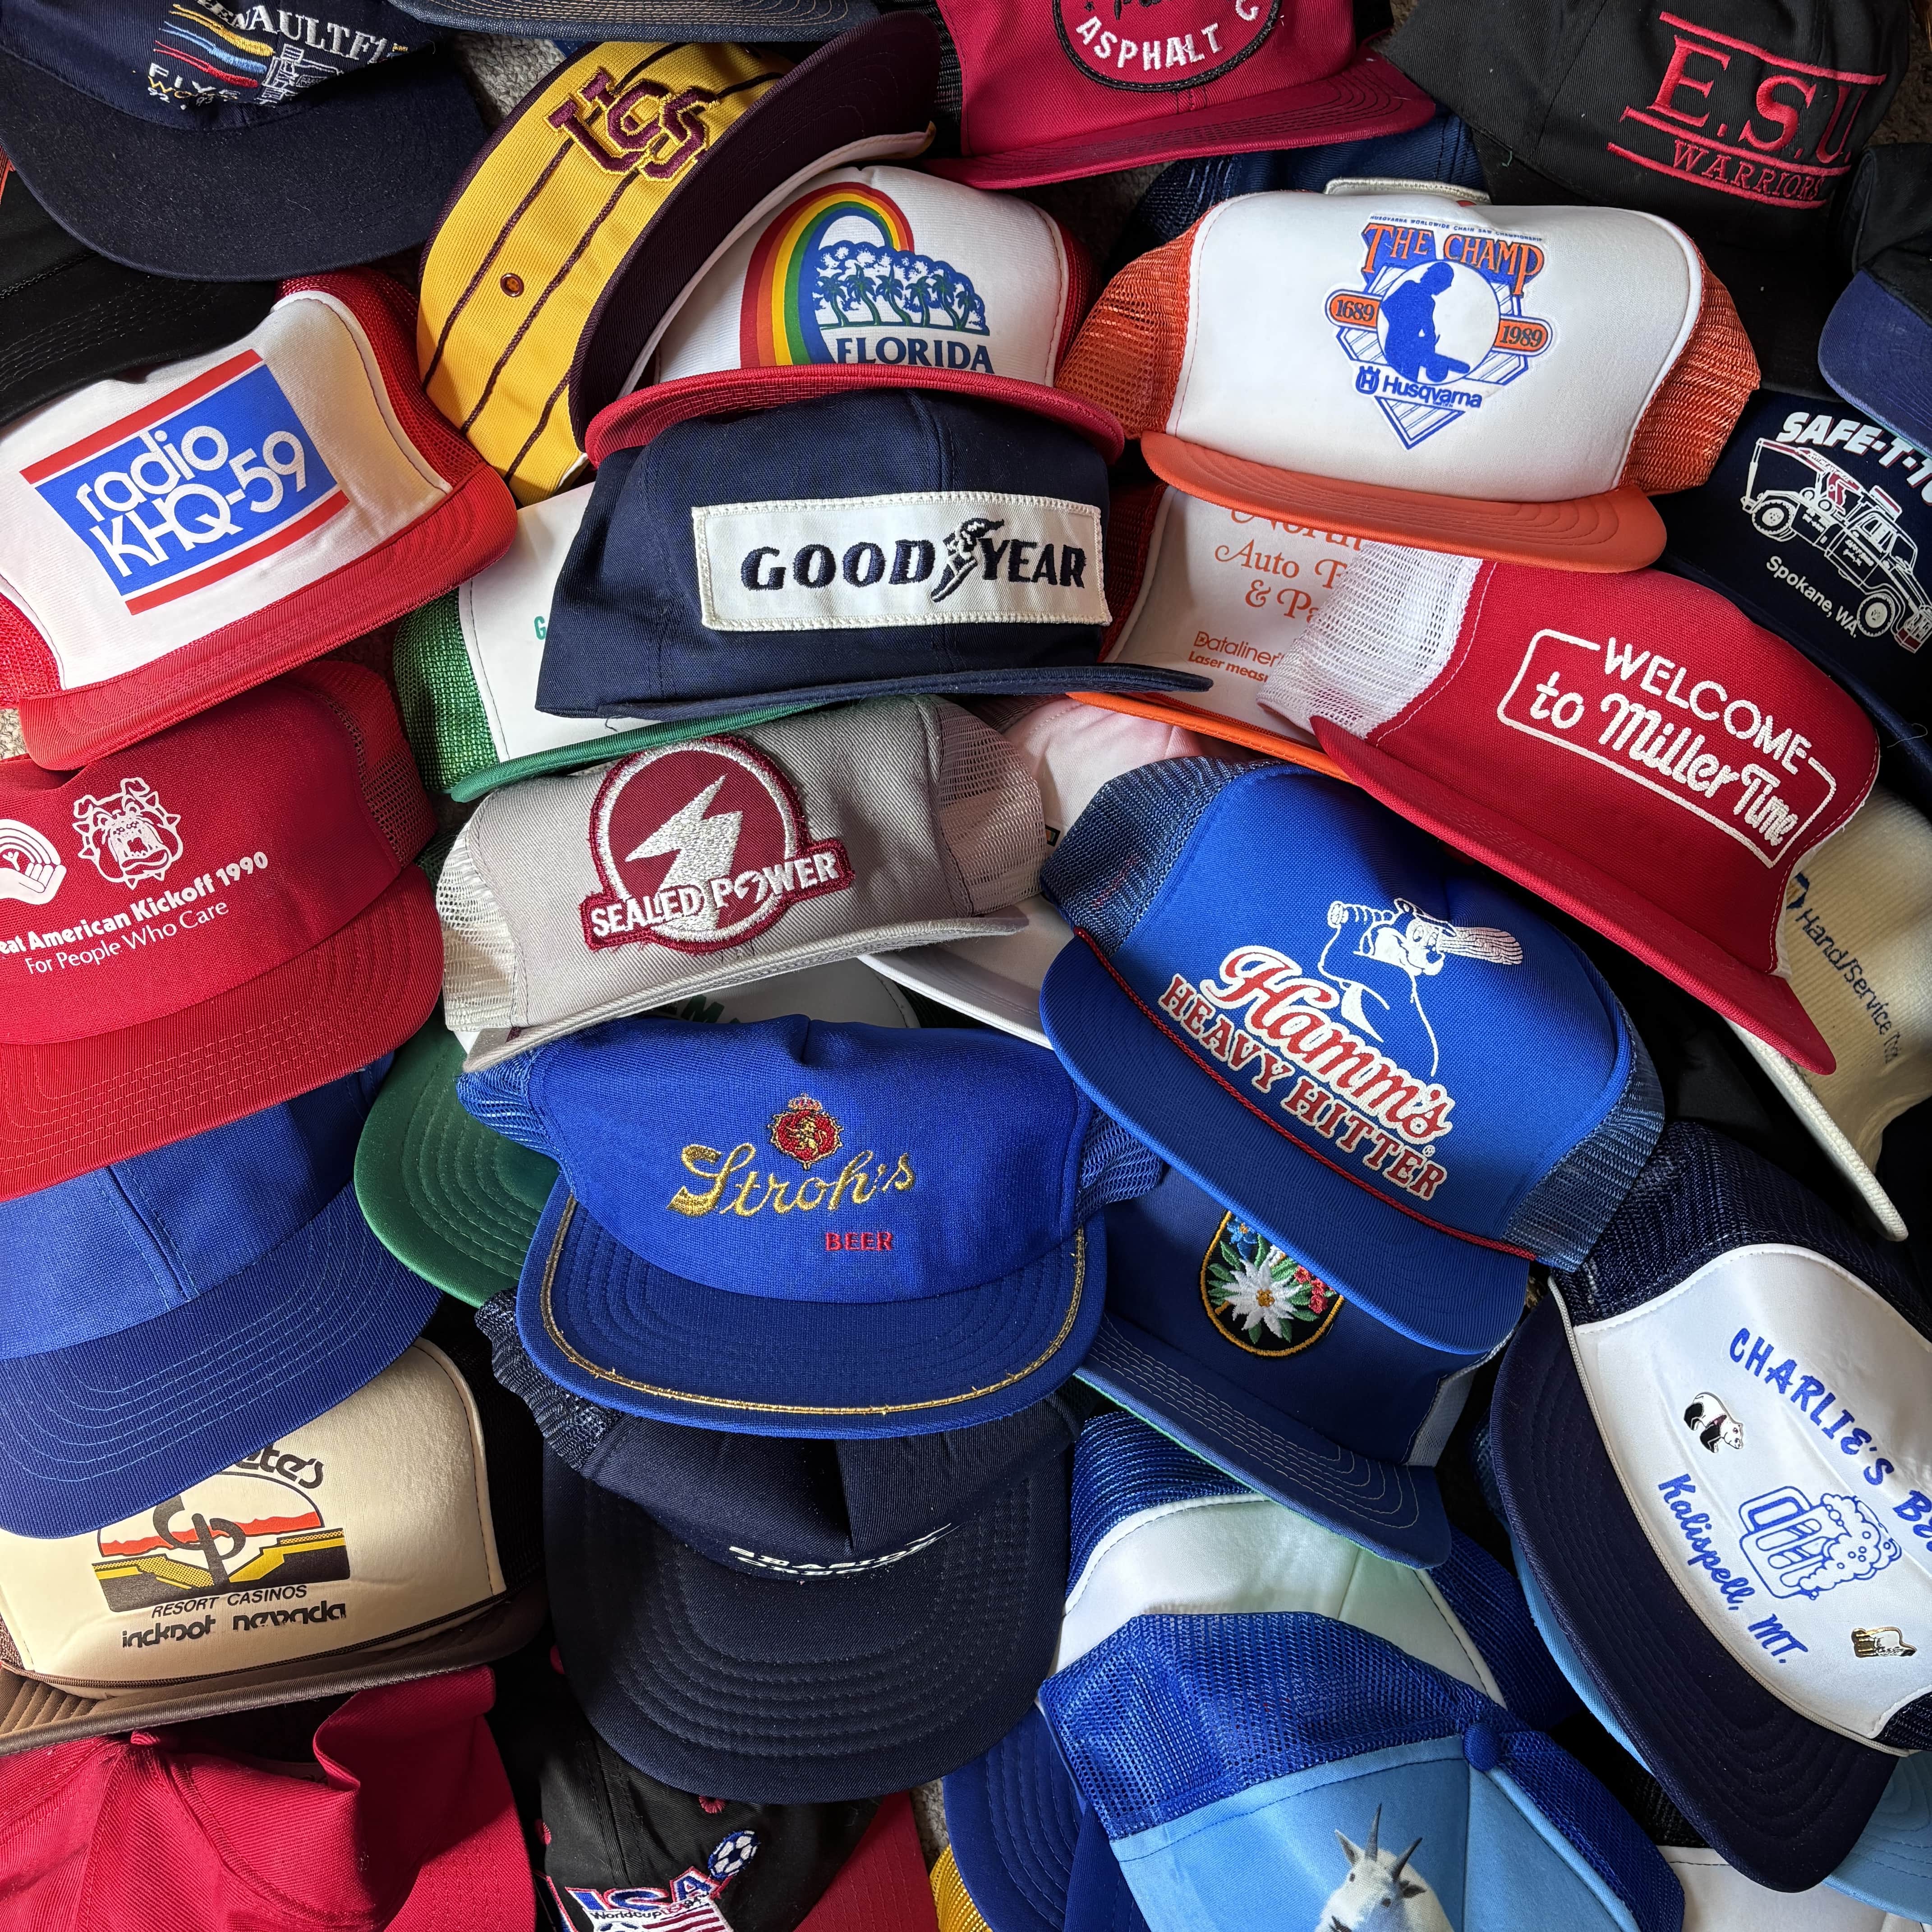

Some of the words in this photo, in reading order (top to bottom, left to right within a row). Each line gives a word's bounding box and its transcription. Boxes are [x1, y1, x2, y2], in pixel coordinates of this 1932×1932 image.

[1076, 16, 1223, 71] ASPHALT
[1672, 139, 1825, 200] WARRIORS
[1411, 220, 1450, 229] WORLDWIDE
[1361, 223, 1433, 274] THE
[1444, 234, 1544, 298] CHAMP
[1336, 299, 1375, 321] 1689
[1500, 325, 1544, 348] 1989
[836, 337, 995, 374] FLORIDA
[1383, 375, 1483, 408] Husqvarna
[76, 425, 229, 522] radio
[89, 431, 307, 578] KHQ-59
[1215, 538, 1300, 579] Auto
[1766, 556, 1832, 618] Spokane,
[1245, 580, 1271, 607] &
[1188, 651, 1225, 668] Laser
[1604, 637, 1812, 775] WELCOME
[1529, 671, 1585, 729] to
[1598, 693, 1739, 799] Miller
[1733, 763, 1799, 846] Time
[0, 935, 27, 955] eat
[28, 919, 131, 950] American
[130, 876, 216, 922] Kickoff
[215, 851, 268, 887] 1990
[590, 884, 705, 938] SEALED
[709, 851, 840, 911] POWER
[25, 957, 53, 975] For
[56, 940, 121, 969] People
[121, 921, 177, 950] Who
[179, 902, 230, 929] Care
[1200, 945, 1456, 1144] Hamm's
[1158, 973, 1295, 1093] HEAVY
[1281, 1075, 1447, 1201] HITTER
[667, 1142, 915, 1217] Stroh's
[825, 1231, 894, 1252] BEER
[1730, 1327, 1894, 1486] CHARLIE'S
[152, 1597, 220, 1619] RESORT
[227, 1585, 307, 1606] CASINOS
[1658, 1473, 1756, 1610] Kalispell,
[1748, 1613, 1808, 1664] MT.
